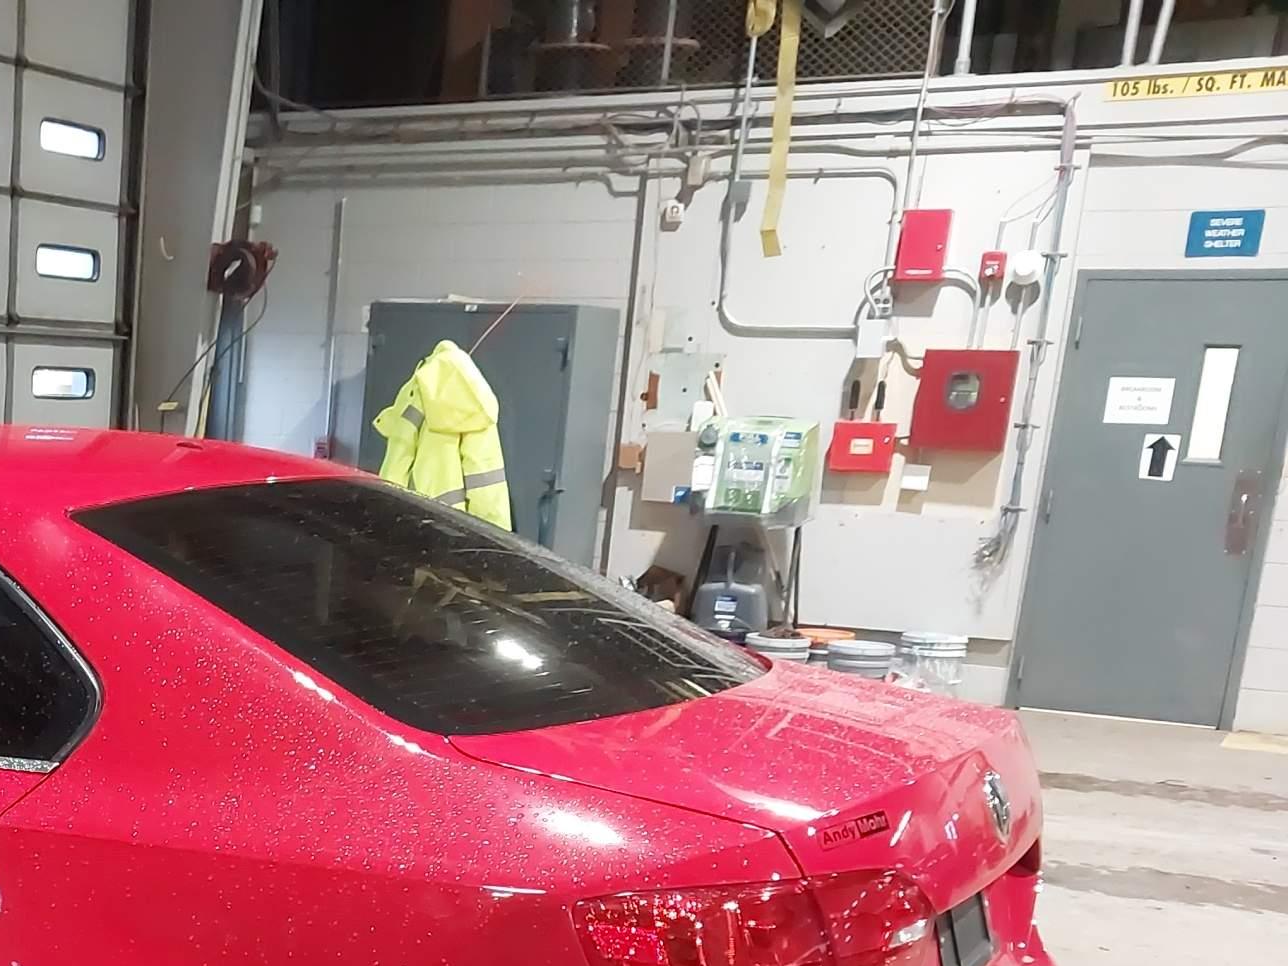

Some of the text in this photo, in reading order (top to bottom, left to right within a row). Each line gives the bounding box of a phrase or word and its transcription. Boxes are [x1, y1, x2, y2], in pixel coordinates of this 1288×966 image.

[1112, 70, 1287, 97] 105 lbs. / SQ. FT. MA
[823, 814, 887, 846] Andy Mohr
